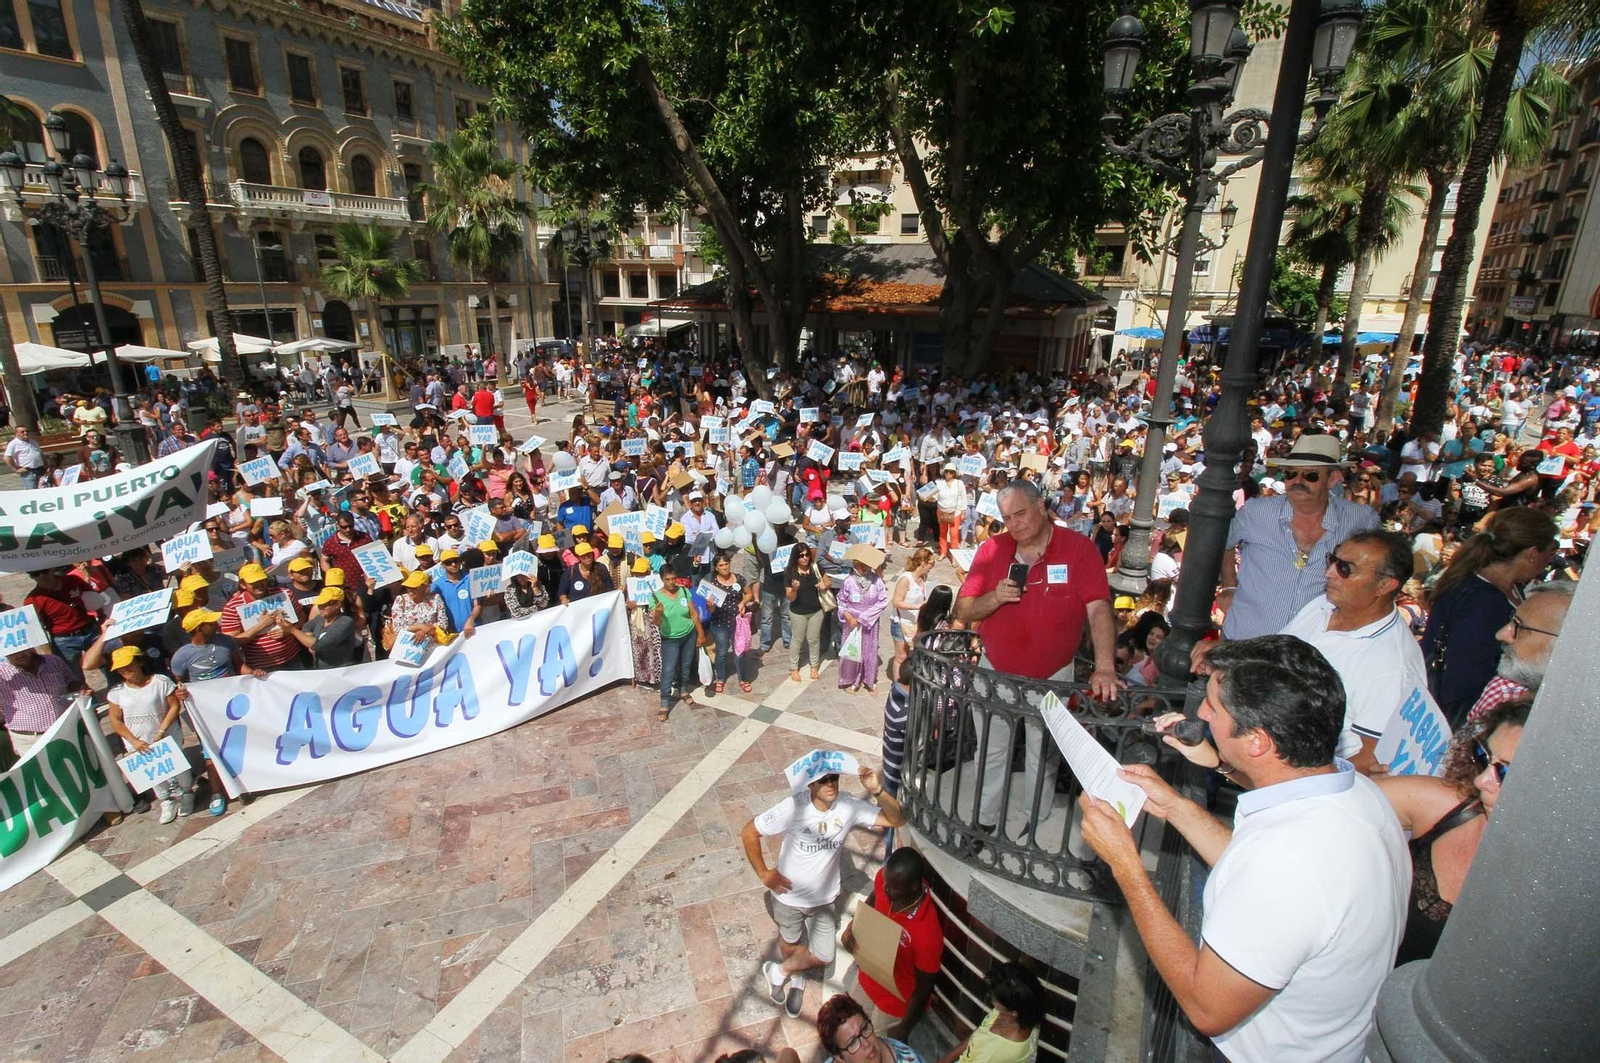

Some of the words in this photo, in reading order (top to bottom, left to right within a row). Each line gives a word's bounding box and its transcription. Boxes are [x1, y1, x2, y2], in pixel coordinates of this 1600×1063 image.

[20, 497, 64, 515] del
[74, 465, 181, 507] PUERTO
[93, 543, 107, 551] en
[168, 517, 183, 525] de
[165, 533, 200, 555] ¡¡AGUA
[174, 547, 198, 564] YA!!
[496, 608, 610, 707] YA!
[1399, 687, 1448, 775] ¡¡AGUA
[126, 741, 172, 773] ¡¡AGUA
[144, 758, 175, 781] YA!!
[792, 750, 845, 776] ¡¡AGUA
[806, 761, 842, 779] YA!!
[800, 838, 843, 852] Emirates
